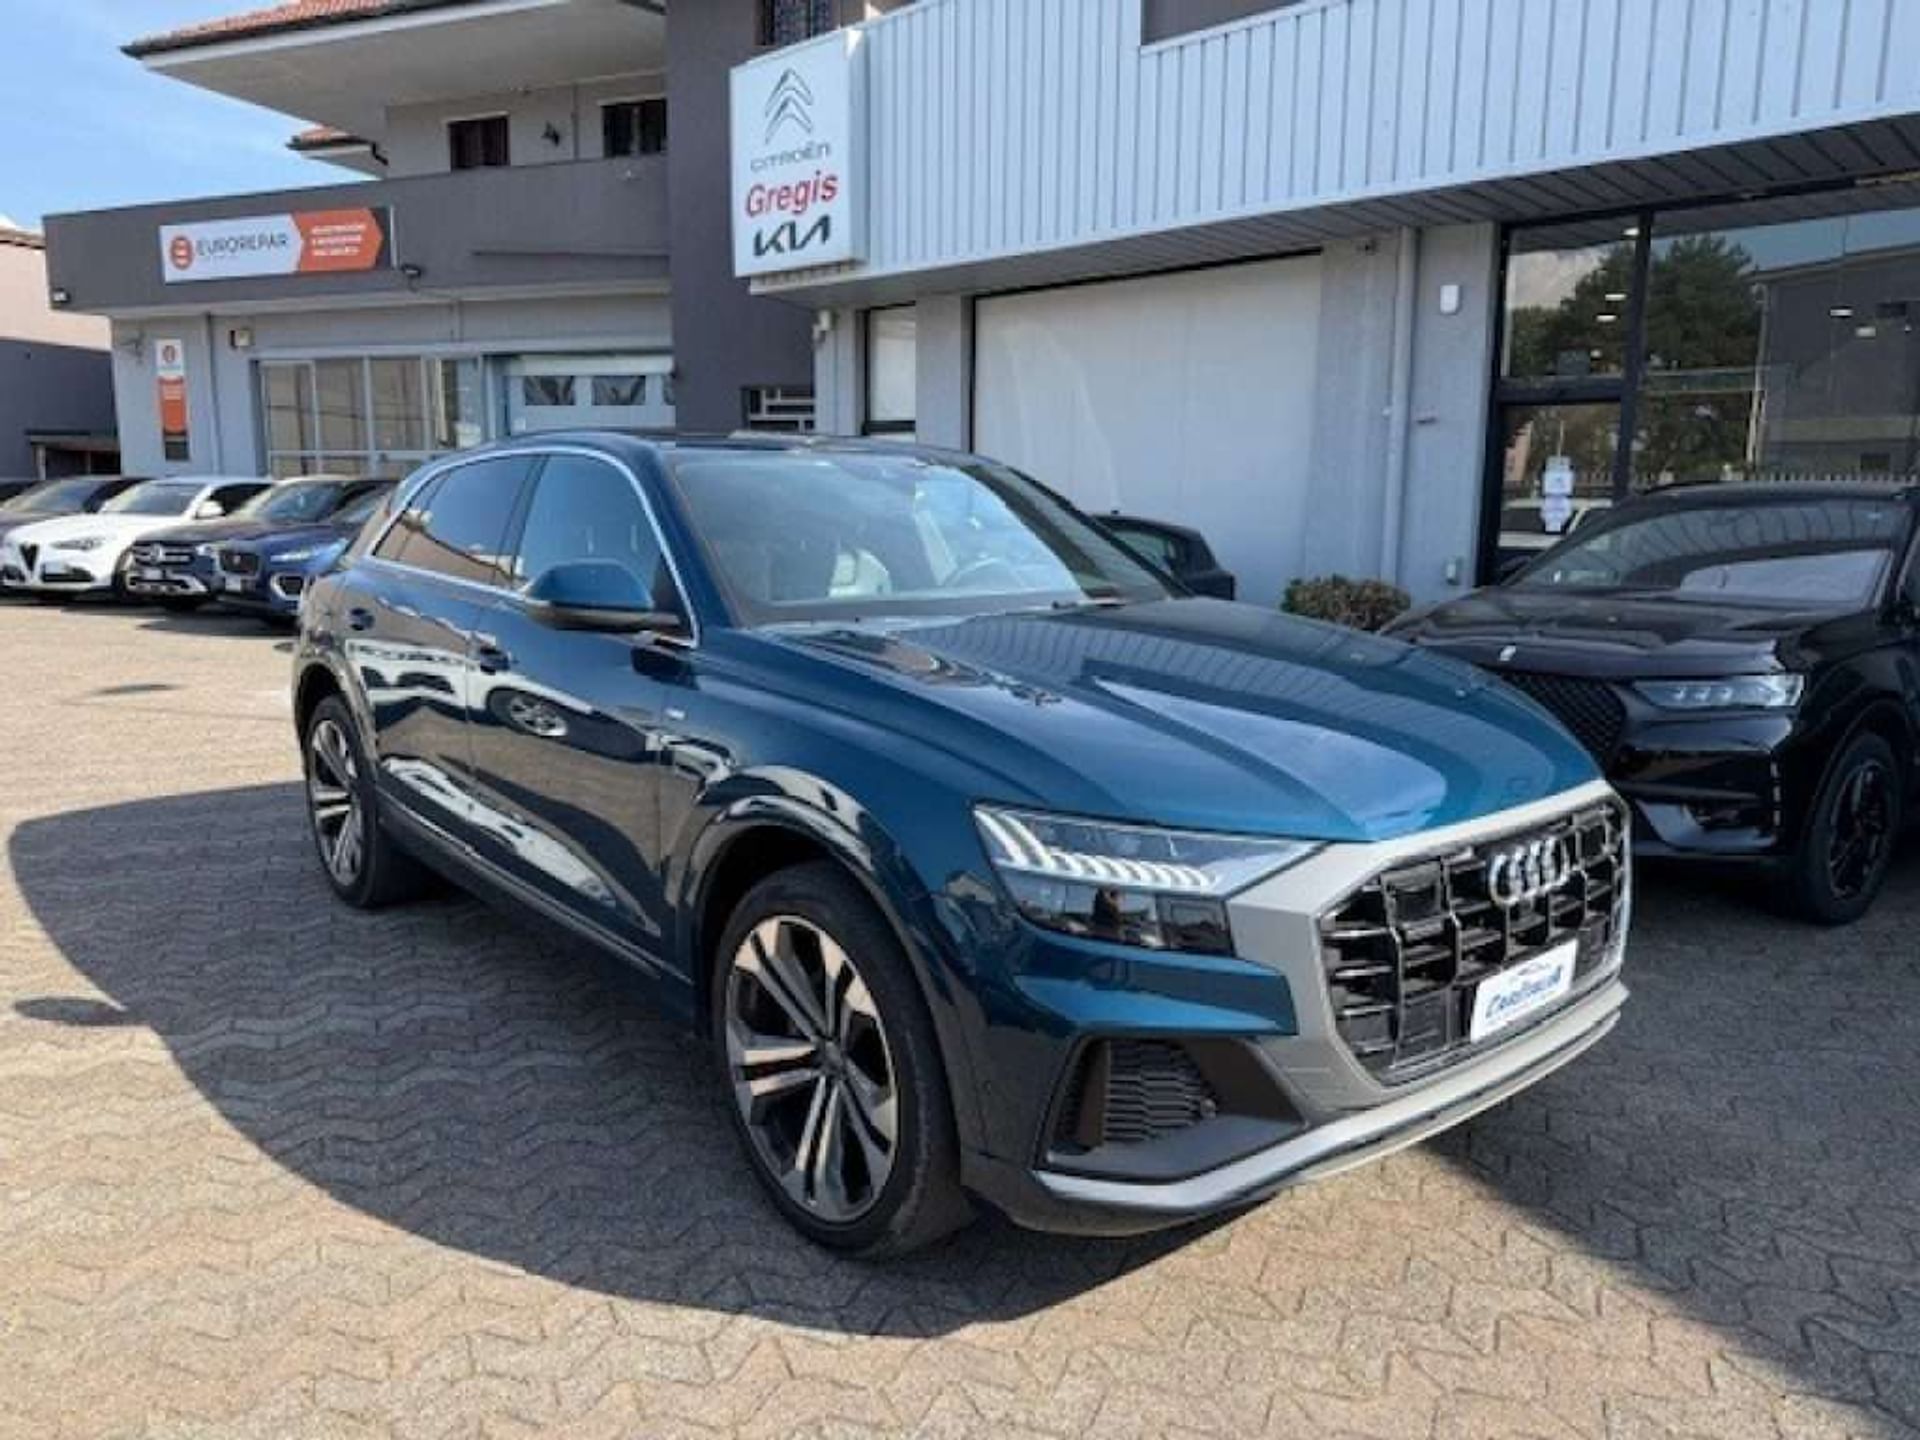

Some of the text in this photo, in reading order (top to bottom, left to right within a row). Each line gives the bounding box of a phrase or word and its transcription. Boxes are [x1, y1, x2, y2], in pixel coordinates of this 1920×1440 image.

[746, 170, 837, 217] Gregis
[196, 233, 289, 257] EUROREPAR
[753, 214, 831, 257] KIA
